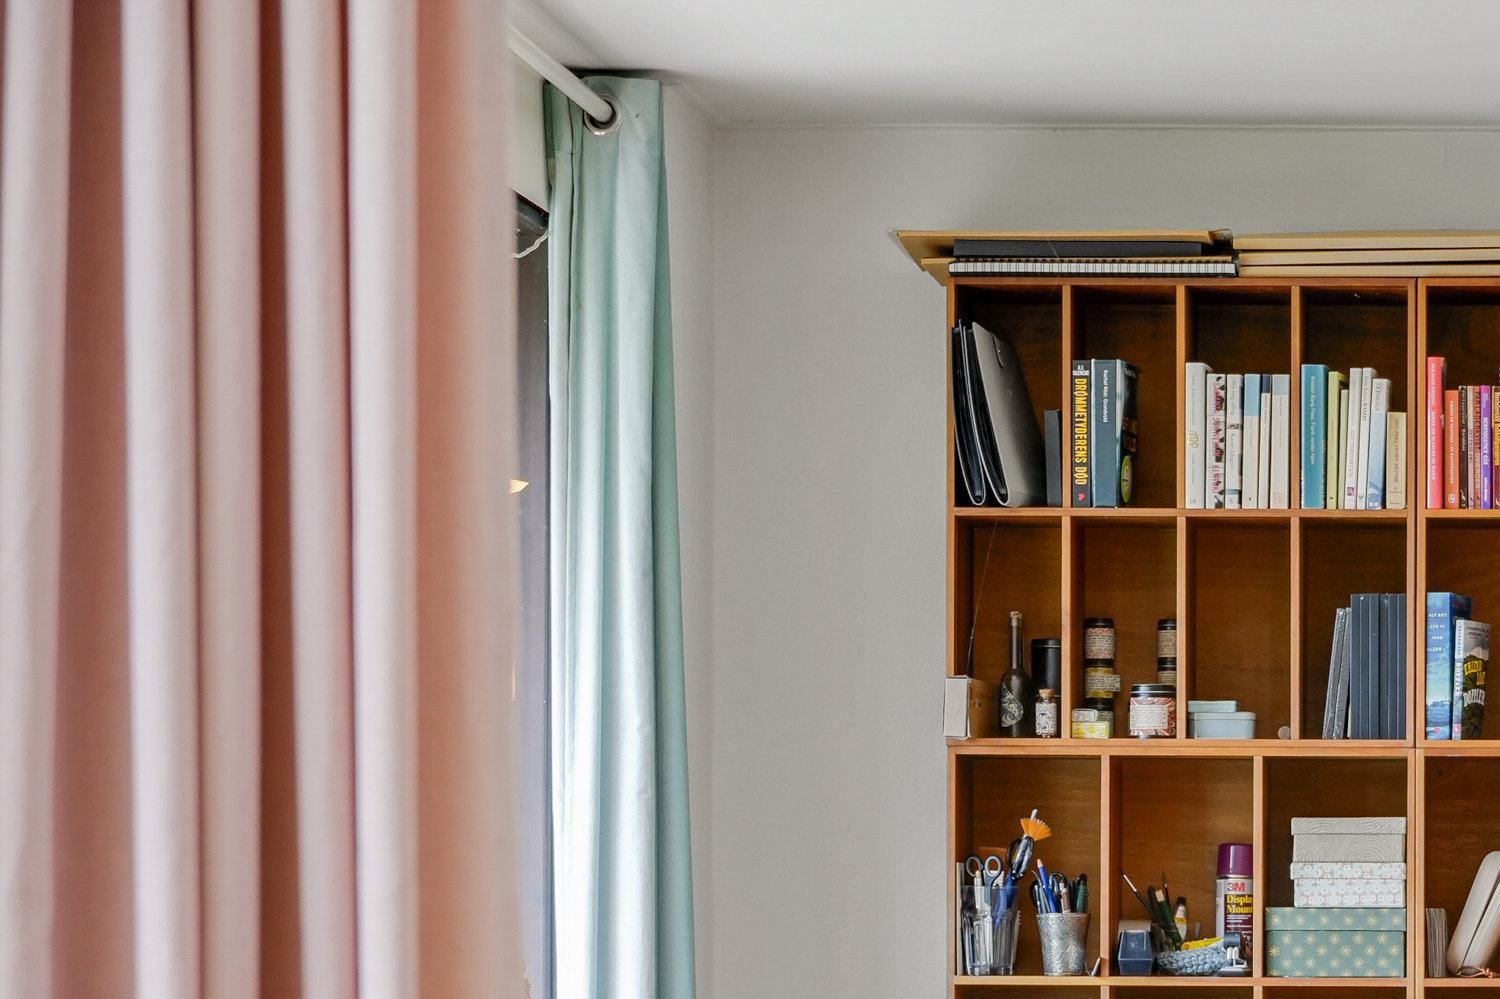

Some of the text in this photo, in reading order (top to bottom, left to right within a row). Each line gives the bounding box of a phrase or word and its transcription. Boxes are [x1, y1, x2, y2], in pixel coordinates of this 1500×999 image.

[1074, 378, 1089, 486] DRØMMETYDERENS DØD
[1227, 882, 1246, 892] 3M
